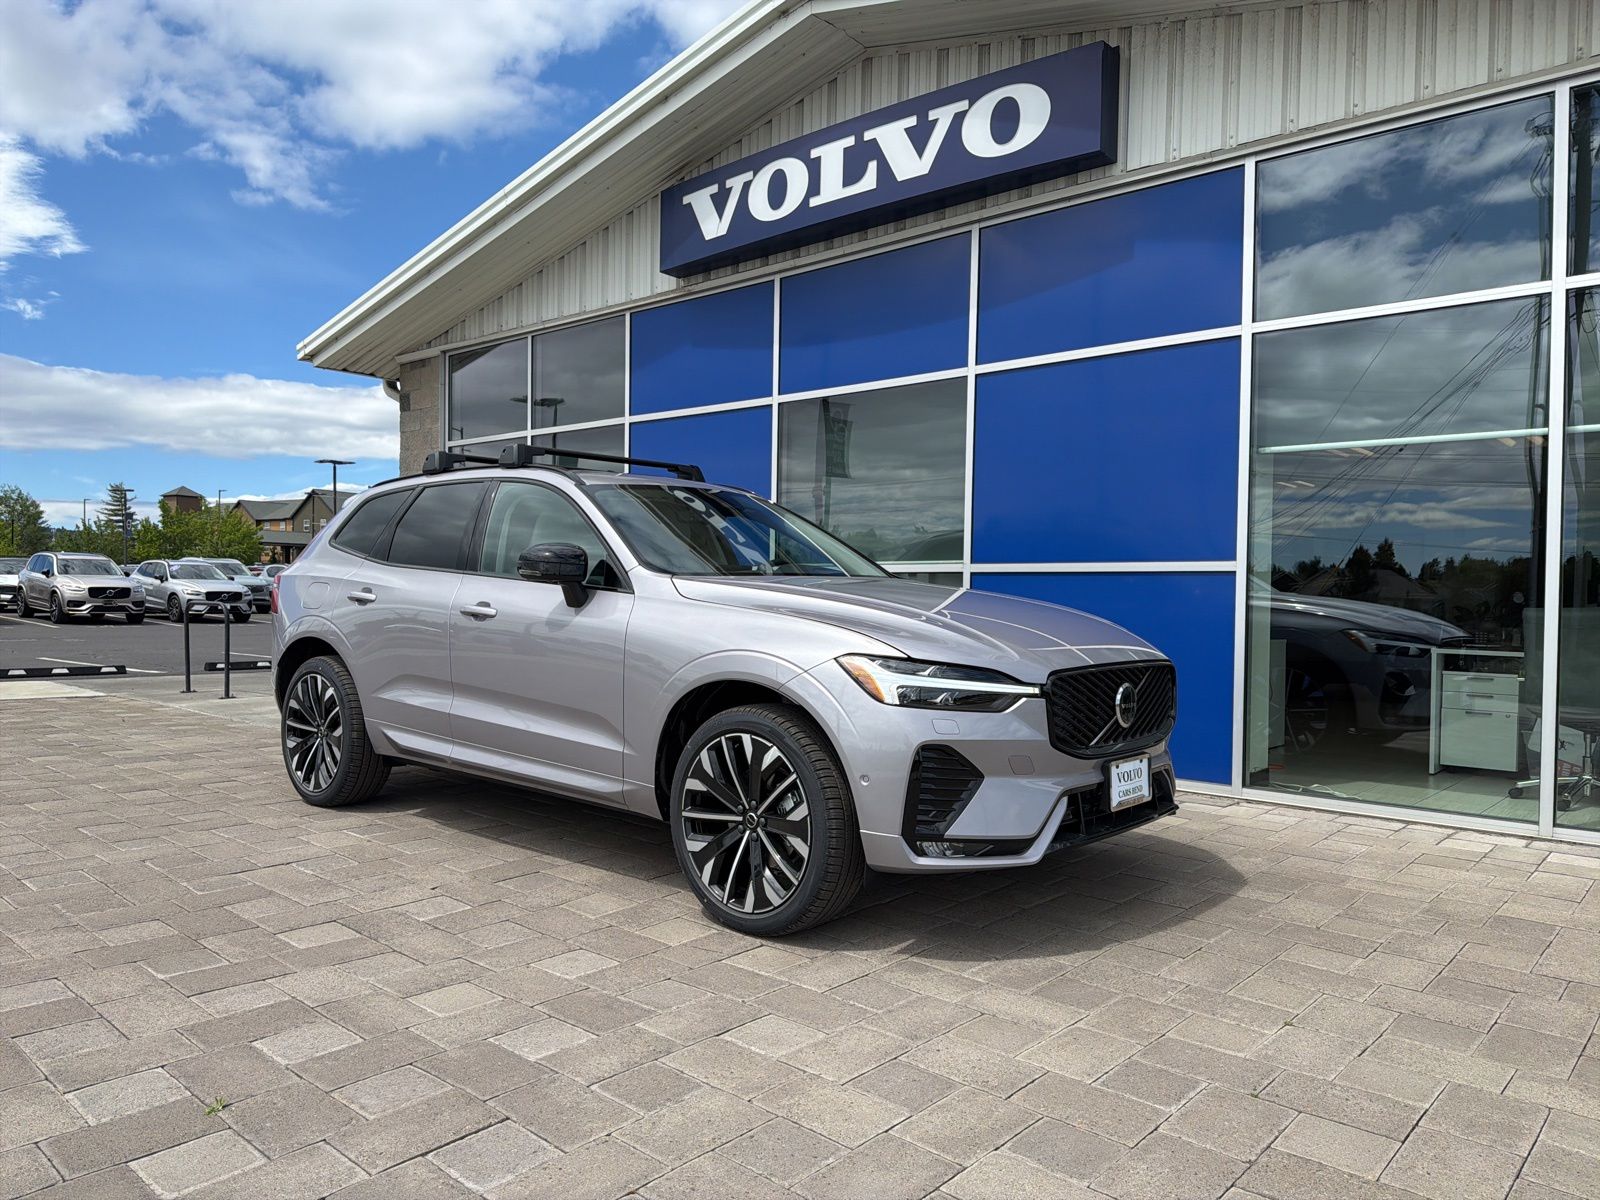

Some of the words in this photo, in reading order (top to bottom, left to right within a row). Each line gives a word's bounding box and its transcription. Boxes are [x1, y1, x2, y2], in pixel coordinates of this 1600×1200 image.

[682, 82, 1052, 242] VOLVO
[1116, 767, 1143, 784] VOLVO
[1118, 788, 1131, 798] CARS
[1131, 784, 1143, 795] BEND
